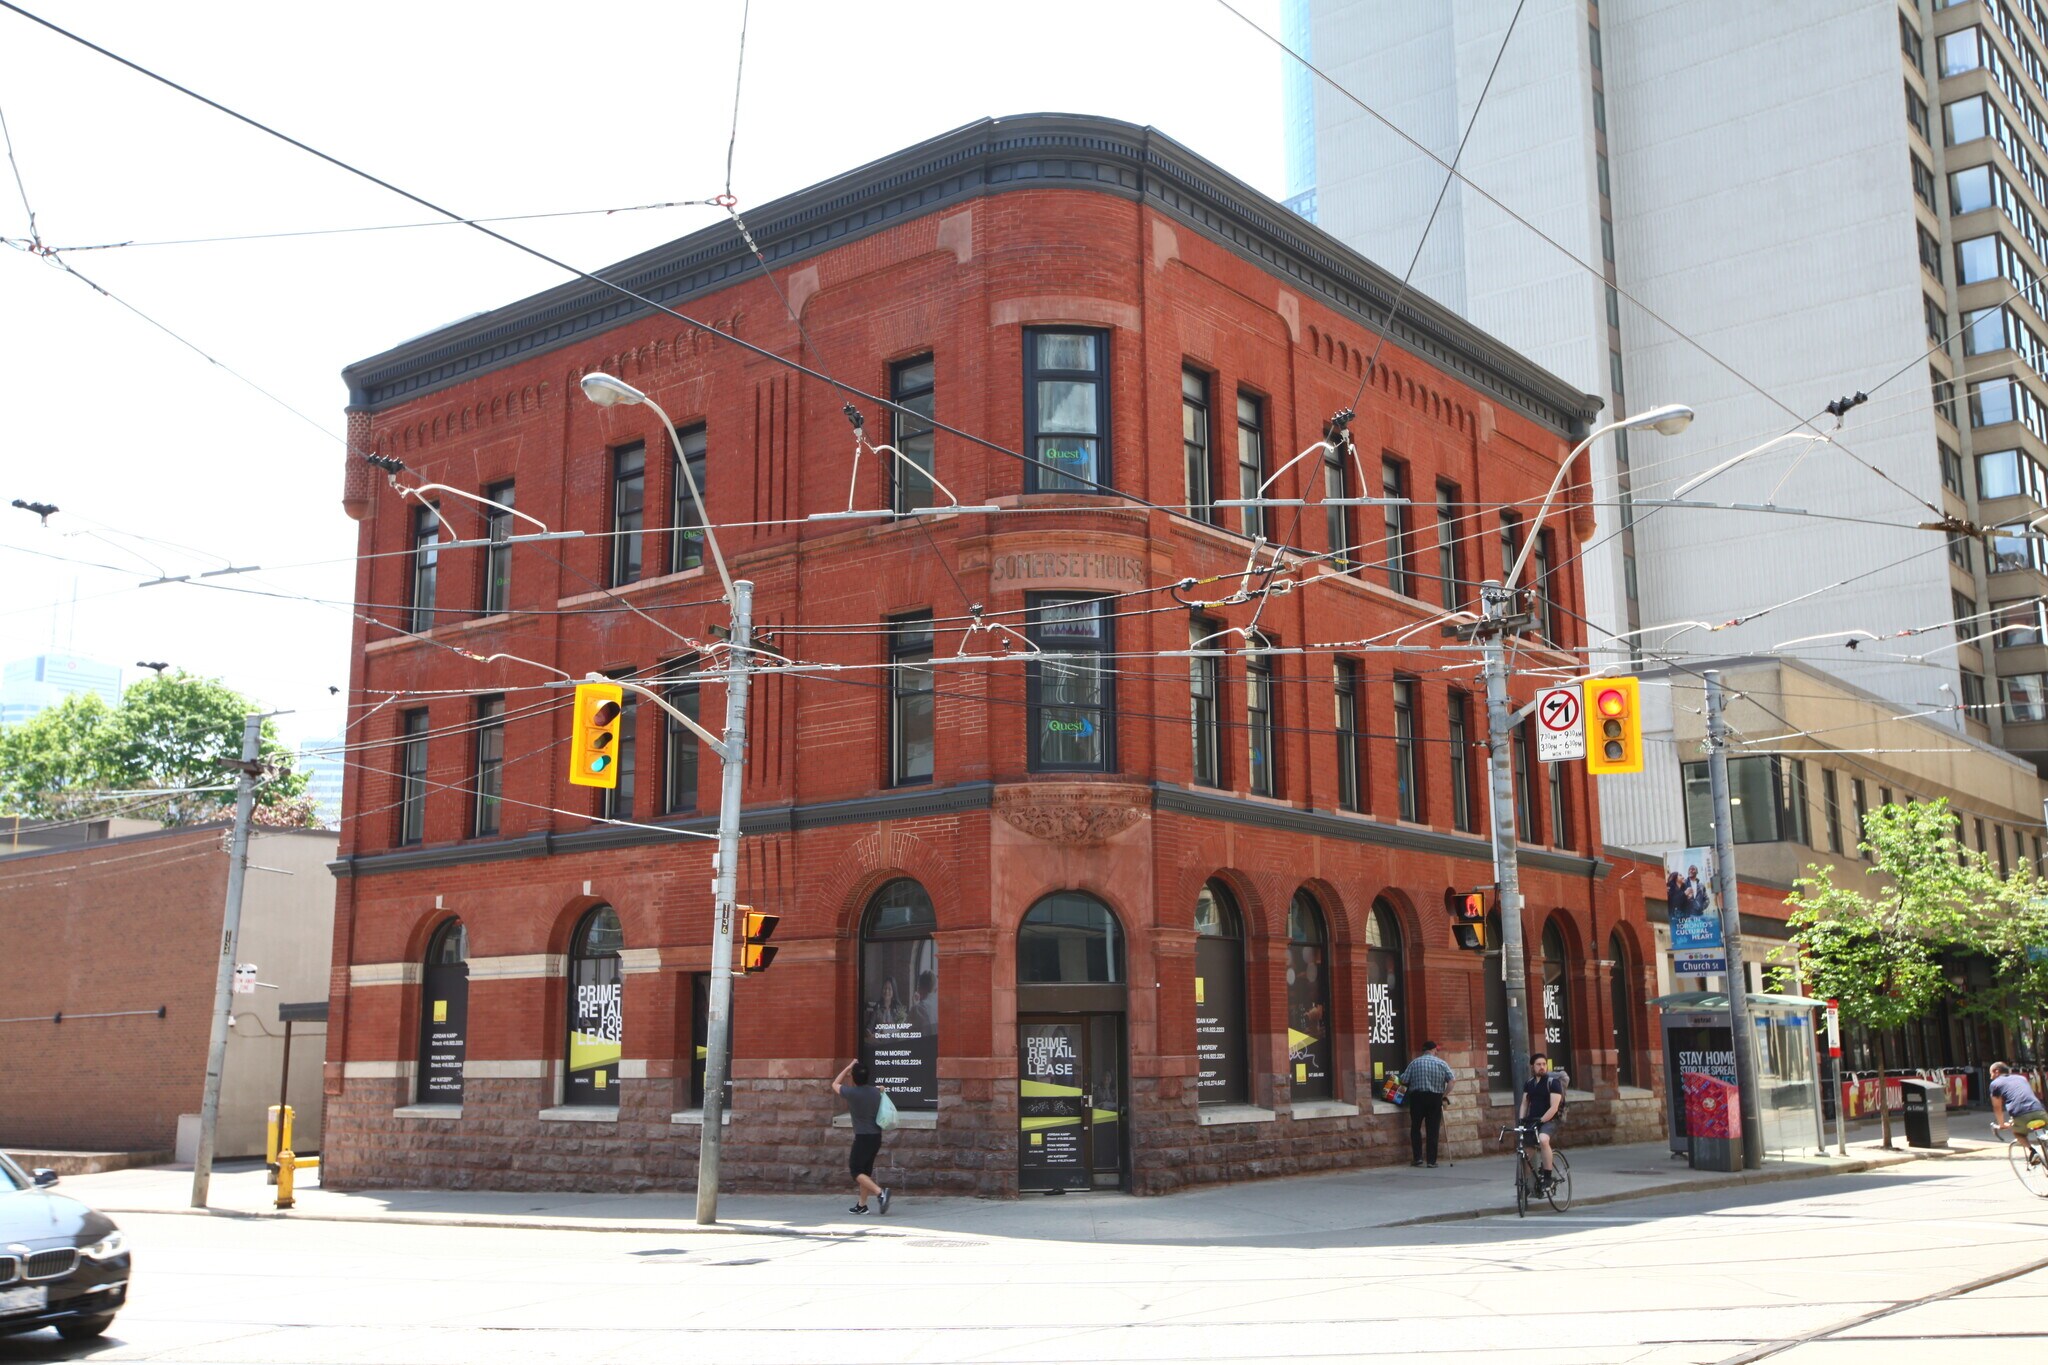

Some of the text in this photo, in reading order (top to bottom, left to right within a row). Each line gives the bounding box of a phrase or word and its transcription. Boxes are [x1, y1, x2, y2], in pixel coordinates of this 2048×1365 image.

[1045, 448, 1079, 459] Quest
[1049, 719, 1083, 731] Quest
[1676, 921, 1713, 930] TORONTO'S
[1675, 928, 1708, 936] CULTURAL
[1683, 961, 1710, 971] Church
[578, 984, 621, 1002] PRIME
[1366, 984, 1389, 1002] RIME
[579, 1000, 622, 1018] RETAI
[1367, 1000, 1396, 1016] ETAIL
[1544, 1004, 1561, 1019] TAIL
[601, 1017, 622, 1029] FOR
[1376, 1015, 1392, 1027] FOR
[577, 1028, 622, 1045] LEASE
[1368, 1026, 1394, 1043] EASE
[1545, 1027, 1560, 1043] ASE
[1027, 1037, 1067, 1048] PRIME
[1028, 1046, 1077, 1058] RETAIL
[1679, 1050, 1735, 1066] STAY HOME
[1027, 1056, 1047, 1065] FOR
[1028, 1064, 1073, 1075] LEASE
[1680, 1066, 1698, 1076] STOP
[1698, 1065, 1711, 1075] THE
